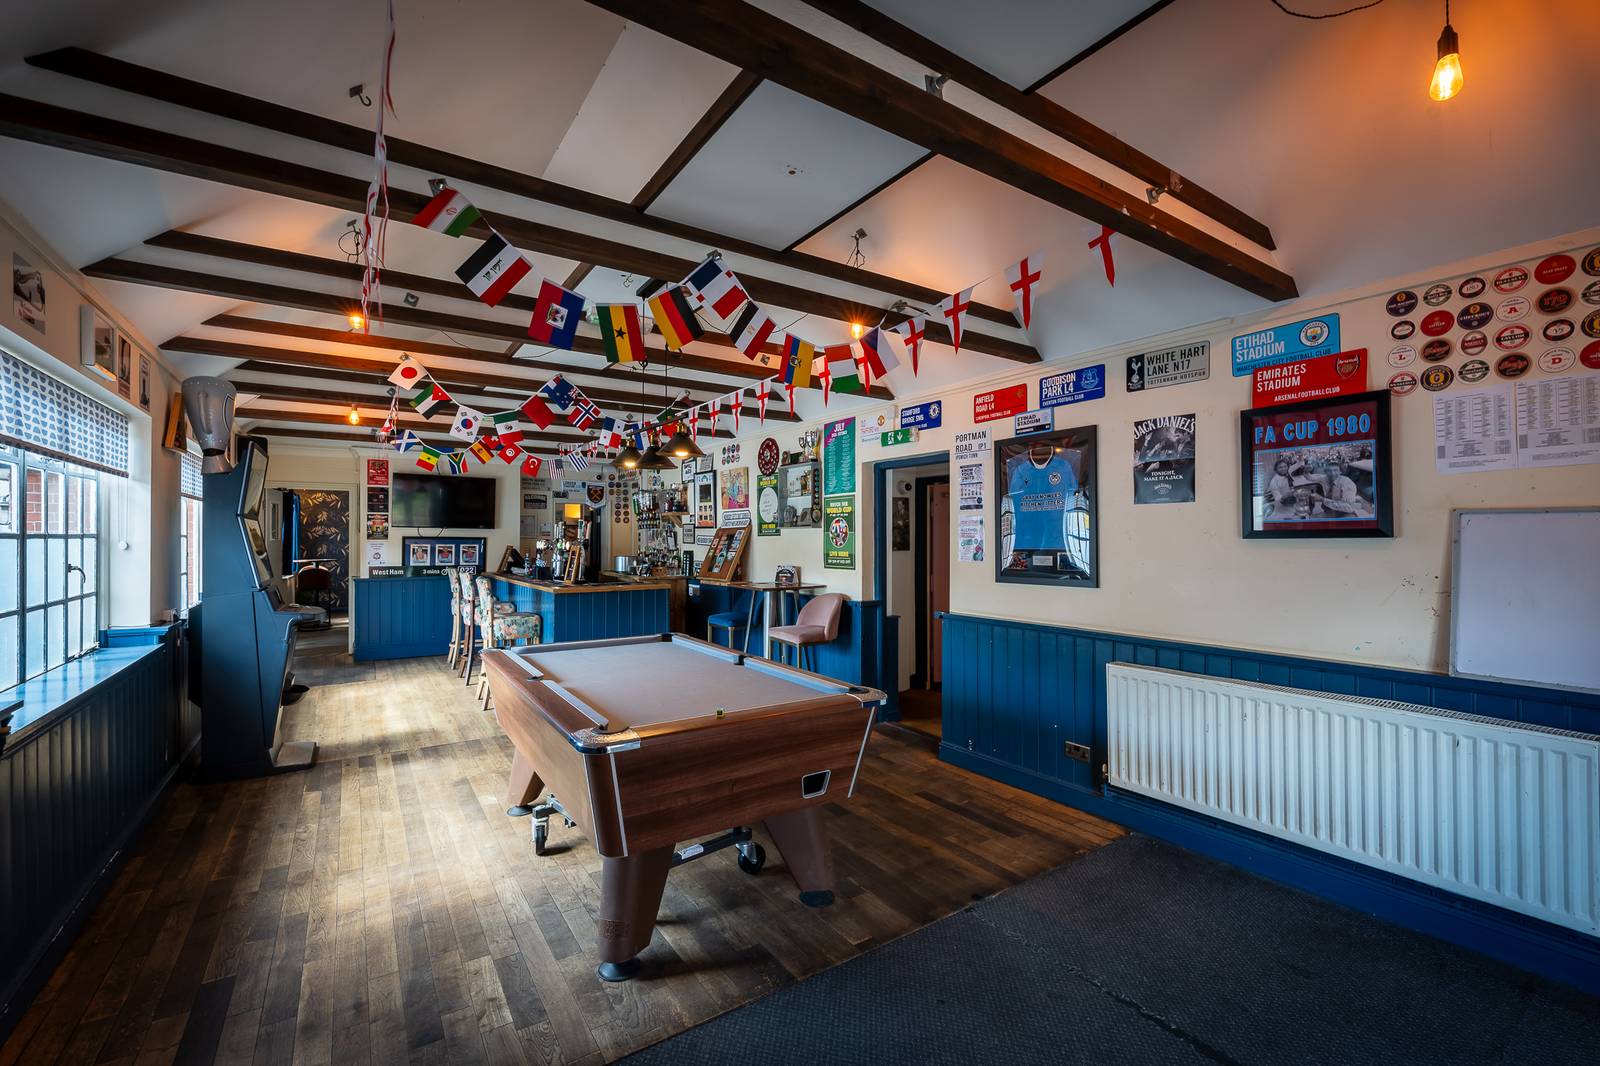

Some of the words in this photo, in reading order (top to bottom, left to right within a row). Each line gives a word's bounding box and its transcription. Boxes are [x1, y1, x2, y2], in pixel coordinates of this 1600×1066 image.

[1235, 331, 1274, 350] ETIHAD
[1147, 351, 1176, 366] WHITE
[1180, 345, 1206, 360] HART
[1236, 341, 1285, 363] STADIUM
[1285, 352, 1313, 364] FOOTBALL
[1147, 363, 1170, 377] LANE
[1173, 359, 1191, 372] N17
[1257, 363, 1307, 381] EMIRATES
[1042, 372, 1076, 388] GOODISON
[1257, 376, 1301, 393] STADIUM
[1042, 385, 1063, 399] PARK
[1064, 382, 1074, 394] L4
[1274, 391, 1298, 402] ARSENAL
[1298, 388, 1325, 399] FOOTBALL
[1325, 386, 1341, 395] CLUB
[975, 394, 995, 404] ANFIELD
[975, 404, 988, 413] ROAD
[988, 403, 995, 411] L4
[1017, 414, 1037, 422] ETIHAD
[1017, 418, 1041, 427] STADIUM
[1133, 419, 1156, 440] JACK
[1157, 416, 1196, 433] DANIEL'S
[1255, 425, 1276, 444] FA
[1284, 420, 1319, 441] CUP
[1326, 413, 1371, 437] 1980
[955, 430, 987, 443] PORTMAN
[955, 443, 973, 453] ROAD
